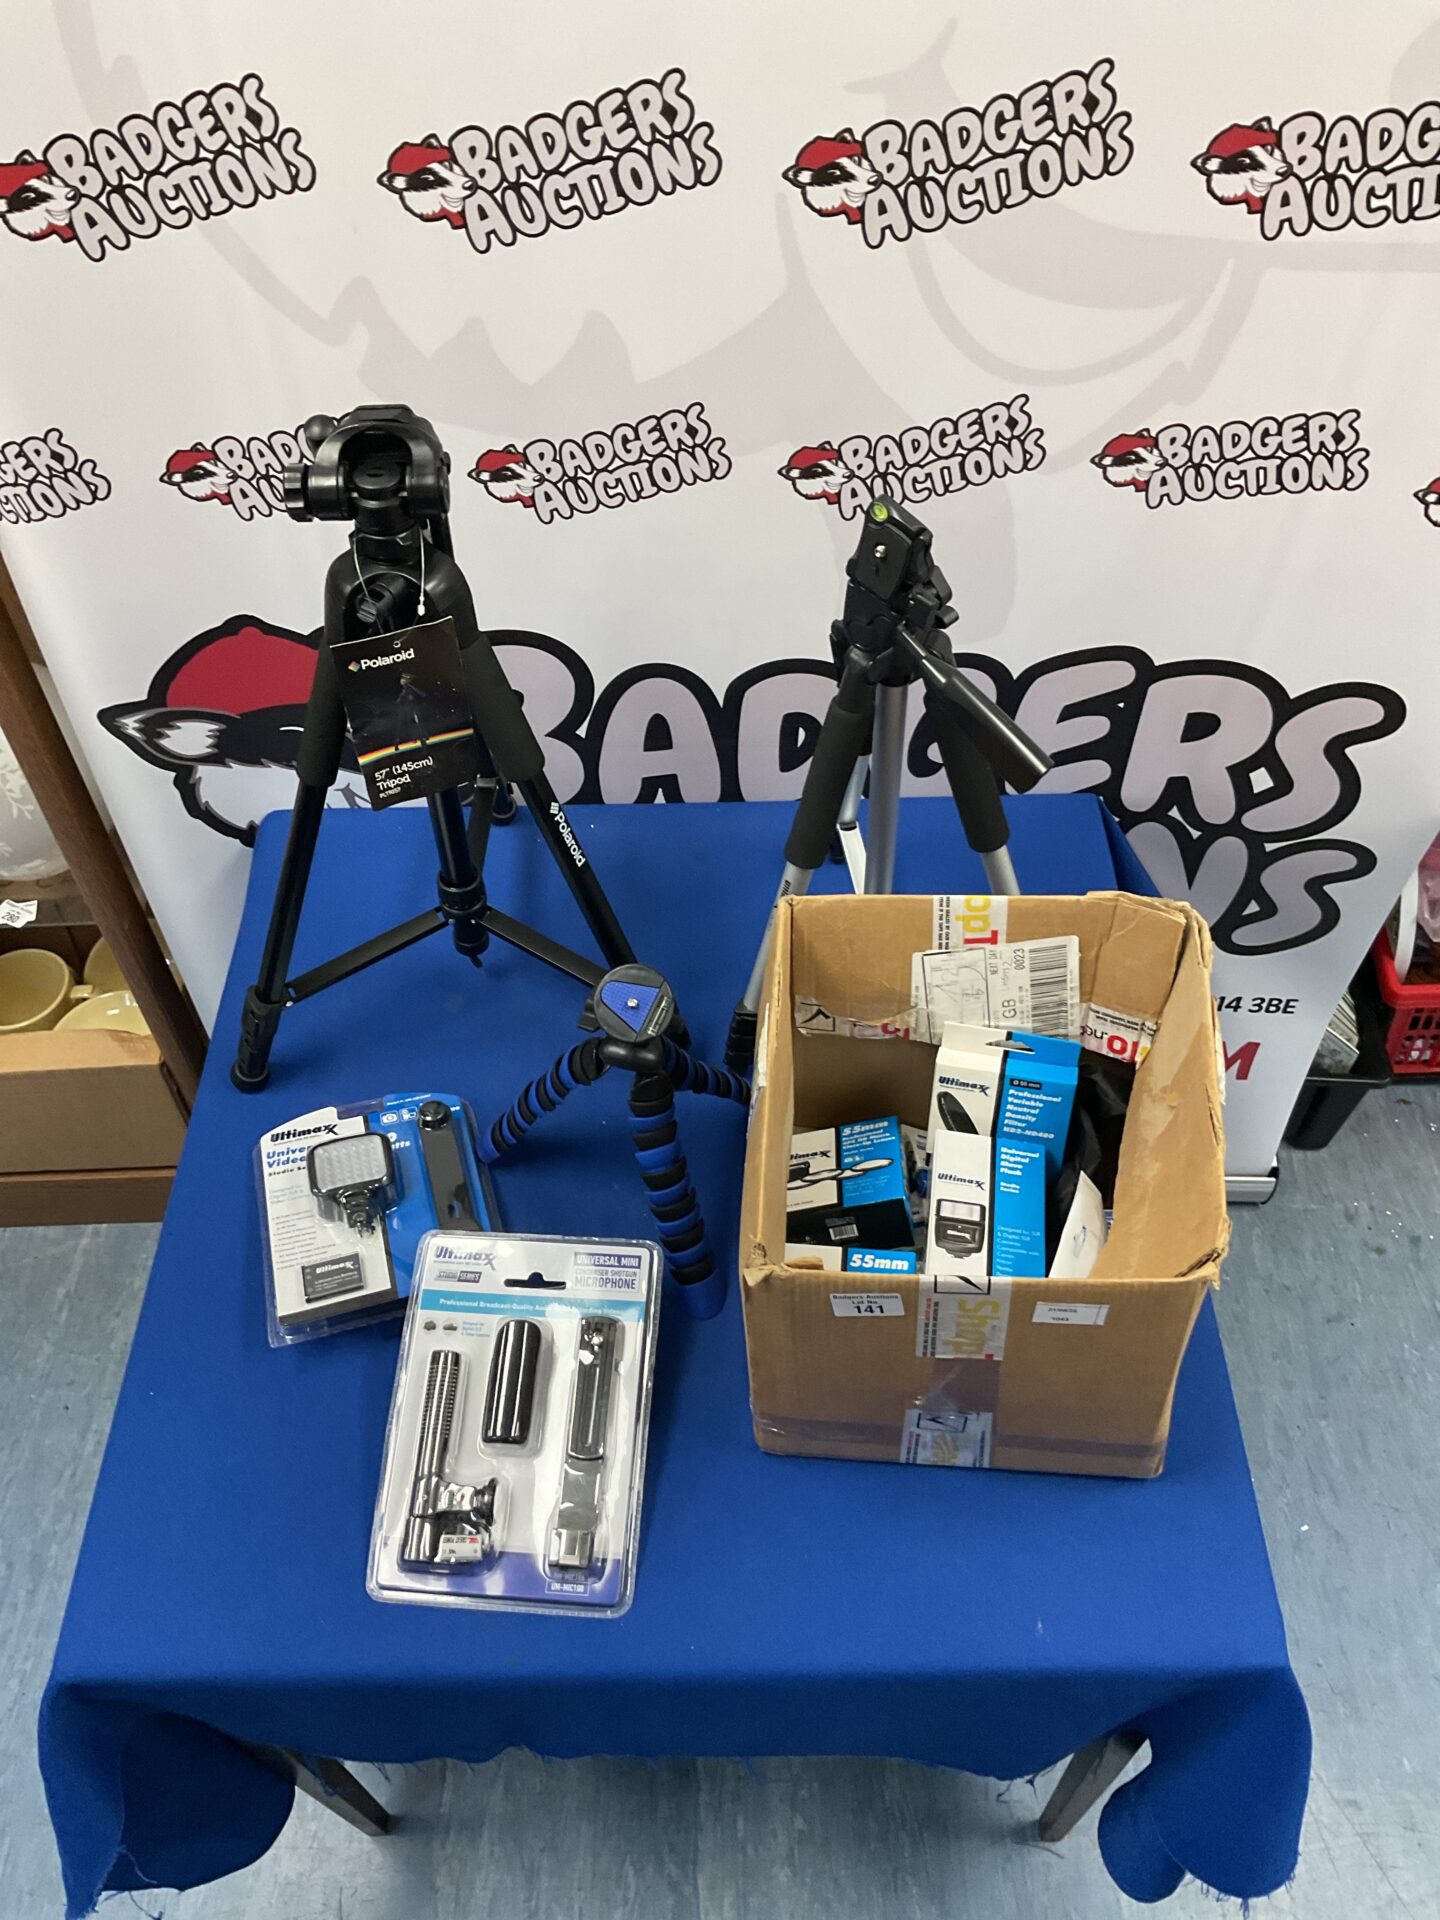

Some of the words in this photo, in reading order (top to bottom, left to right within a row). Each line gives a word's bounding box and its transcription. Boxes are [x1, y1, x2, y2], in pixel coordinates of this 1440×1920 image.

[450, 67, 695, 191] BADGERS
[861, 57, 1117, 184] BADGERS
[44, 73, 279, 197] BADGERS
[465, 121, 724, 254] AUCTIONS
[860, 111, 1134, 249] AUCTIONS
[71, 128, 316, 262] AUCTIONS
[523, 402, 711, 484] BADGERS
[838, 394, 1032, 480] BADGERS
[1156, 408, 1361, 468] BADGERS
[534, 437, 732, 524] AUCTIONS
[838, 428, 1046, 521] AUCTIONS
[1145, 448, 1370, 509] AUCTIONS
[360, 648, 415, 670] Polaroid
[392, 756, 433, 775] (145cm)
[376, 773, 411, 790] Tripod
[554, 811, 586, 867] Polaroid
[989, 948, 999, 960] DAY
[1014, 948, 1026, 971] 0023
[989, 960, 999, 975] NEXT
[1002, 999, 1017, 1019] GB
[1247, 997, 1299, 1015] 3BE
[1007, 1096, 1044, 1107] Variable
[1008, 1089, 1062, 1103] Professional
[1005, 1111, 1037, 1122] Density
[1006, 1104, 1040, 1114] Neutral
[842, 1121, 888, 1136] 55mm
[1004, 1119, 1027, 1127] Filter
[1001, 1146, 1040, 1158] Universal
[1001, 1154, 1029, 1163] Digital
[268, 1169, 295, 1177] Studio
[1000, 1161, 1023, 1169] Slave
[1000, 1167, 1022, 1176] Flash
[577, 1254, 619, 1266] UNIVERSAL
[620, 1256, 639, 1267] MINI
[850, 1254, 909, 1271] 55mm
[610, 1269, 637, 1278] SHOTGUN
[575, 1276, 636, 1290] MICROPHONE
[439, 1298, 478, 1308] Professional
[854, 1304, 884, 1314] 141
